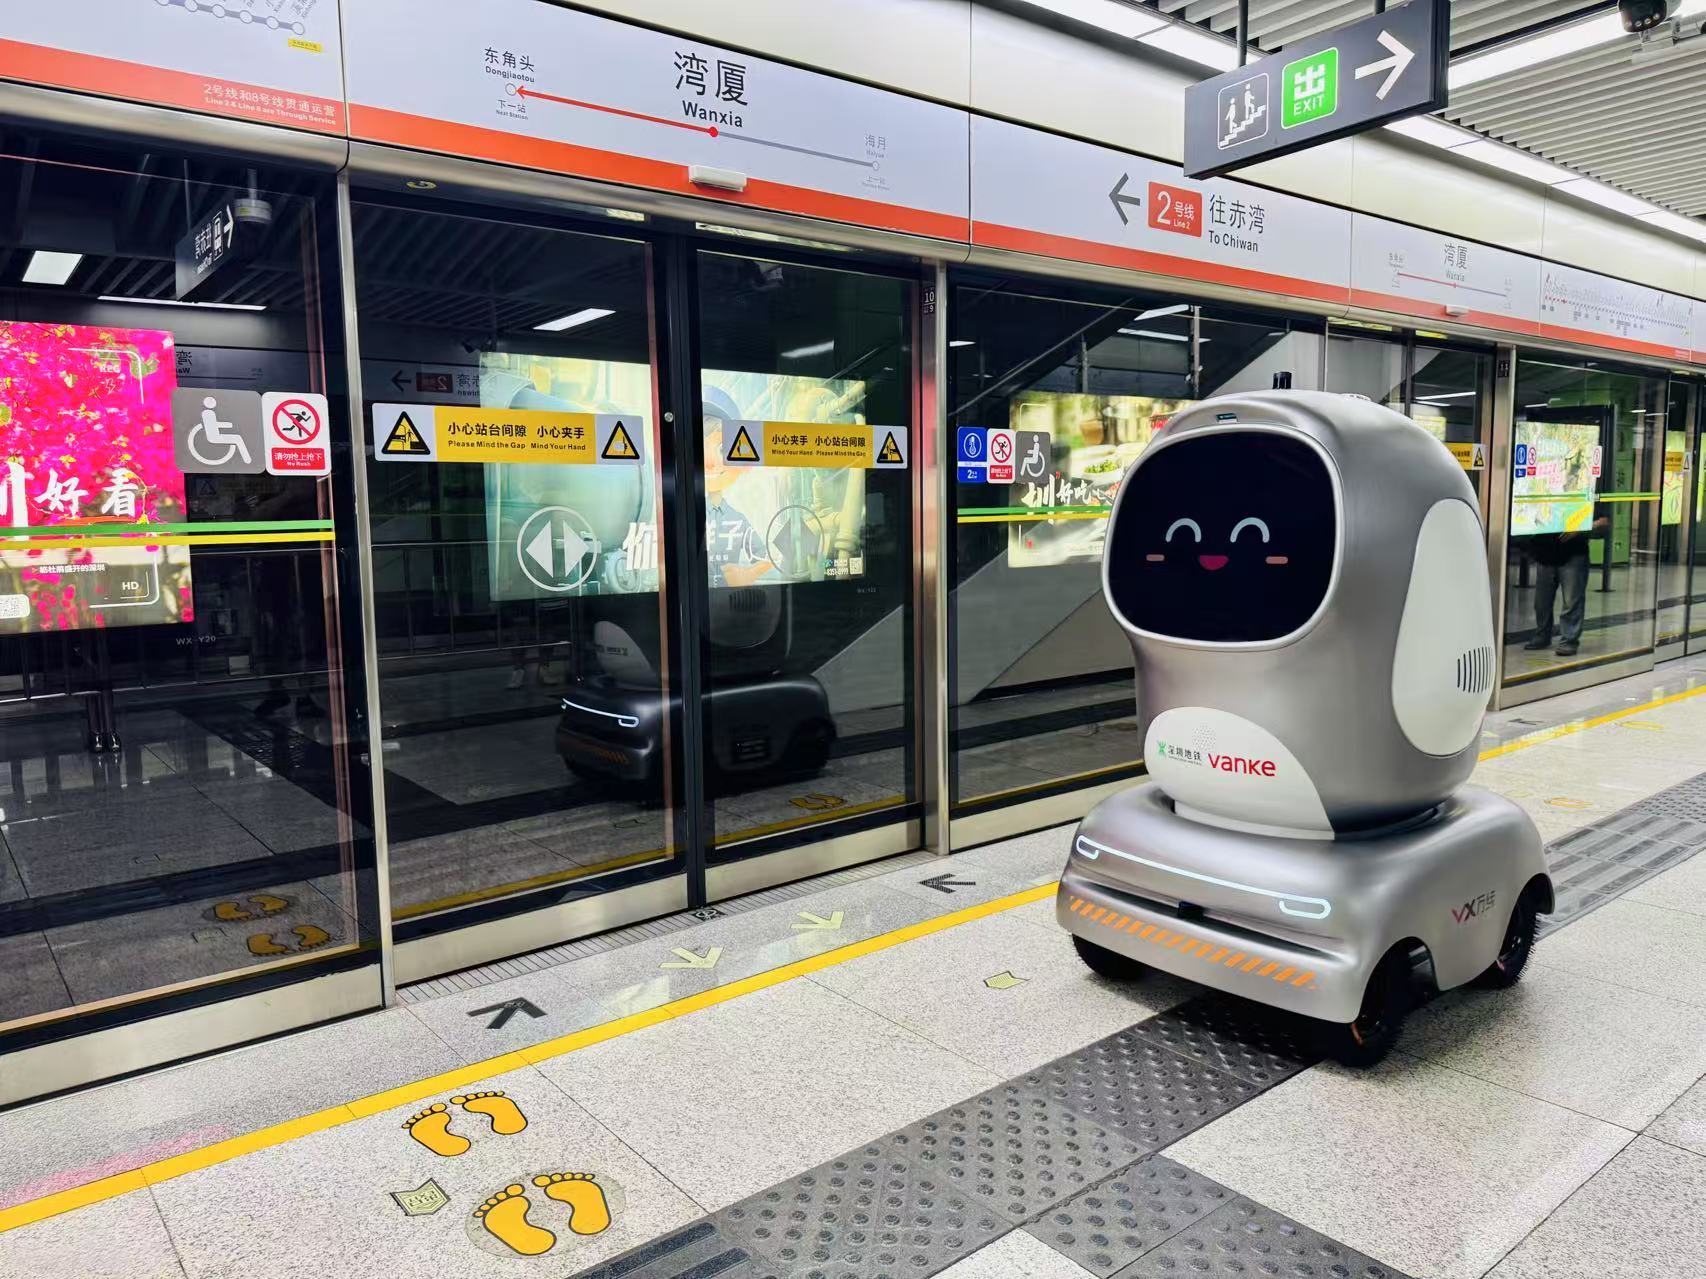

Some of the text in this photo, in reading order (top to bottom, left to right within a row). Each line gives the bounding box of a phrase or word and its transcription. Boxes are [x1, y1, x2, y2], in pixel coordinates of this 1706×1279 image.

[484, 46, 535, 72] 东角头
[485, 65, 535, 83] Dongjiaotou
[673, 51, 748, 106] 湾厦
[203, 84, 335, 117] 2号线和8号线贯通运营
[498, 99, 526, 113] 下一站
[1293, 95, 1323, 117] EXIT
[682, 100, 743, 127] Wanxia
[1157, 191, 1265, 234] 2号线 往赤湾
[1209, 230, 1259, 252] To Chiwan
[447, 421, 585, 439] 小心站台间隙 小心夹手
[771, 434, 866, 448] 小心夹手 小心站台间隙
[448, 440, 586, 451] Please Mind the Gap Mind Your Hand
[122, 582, 139, 590] HD
[1168, 744, 1202, 761] 深圳地铁
[1208, 753, 1276, 777] vanke
